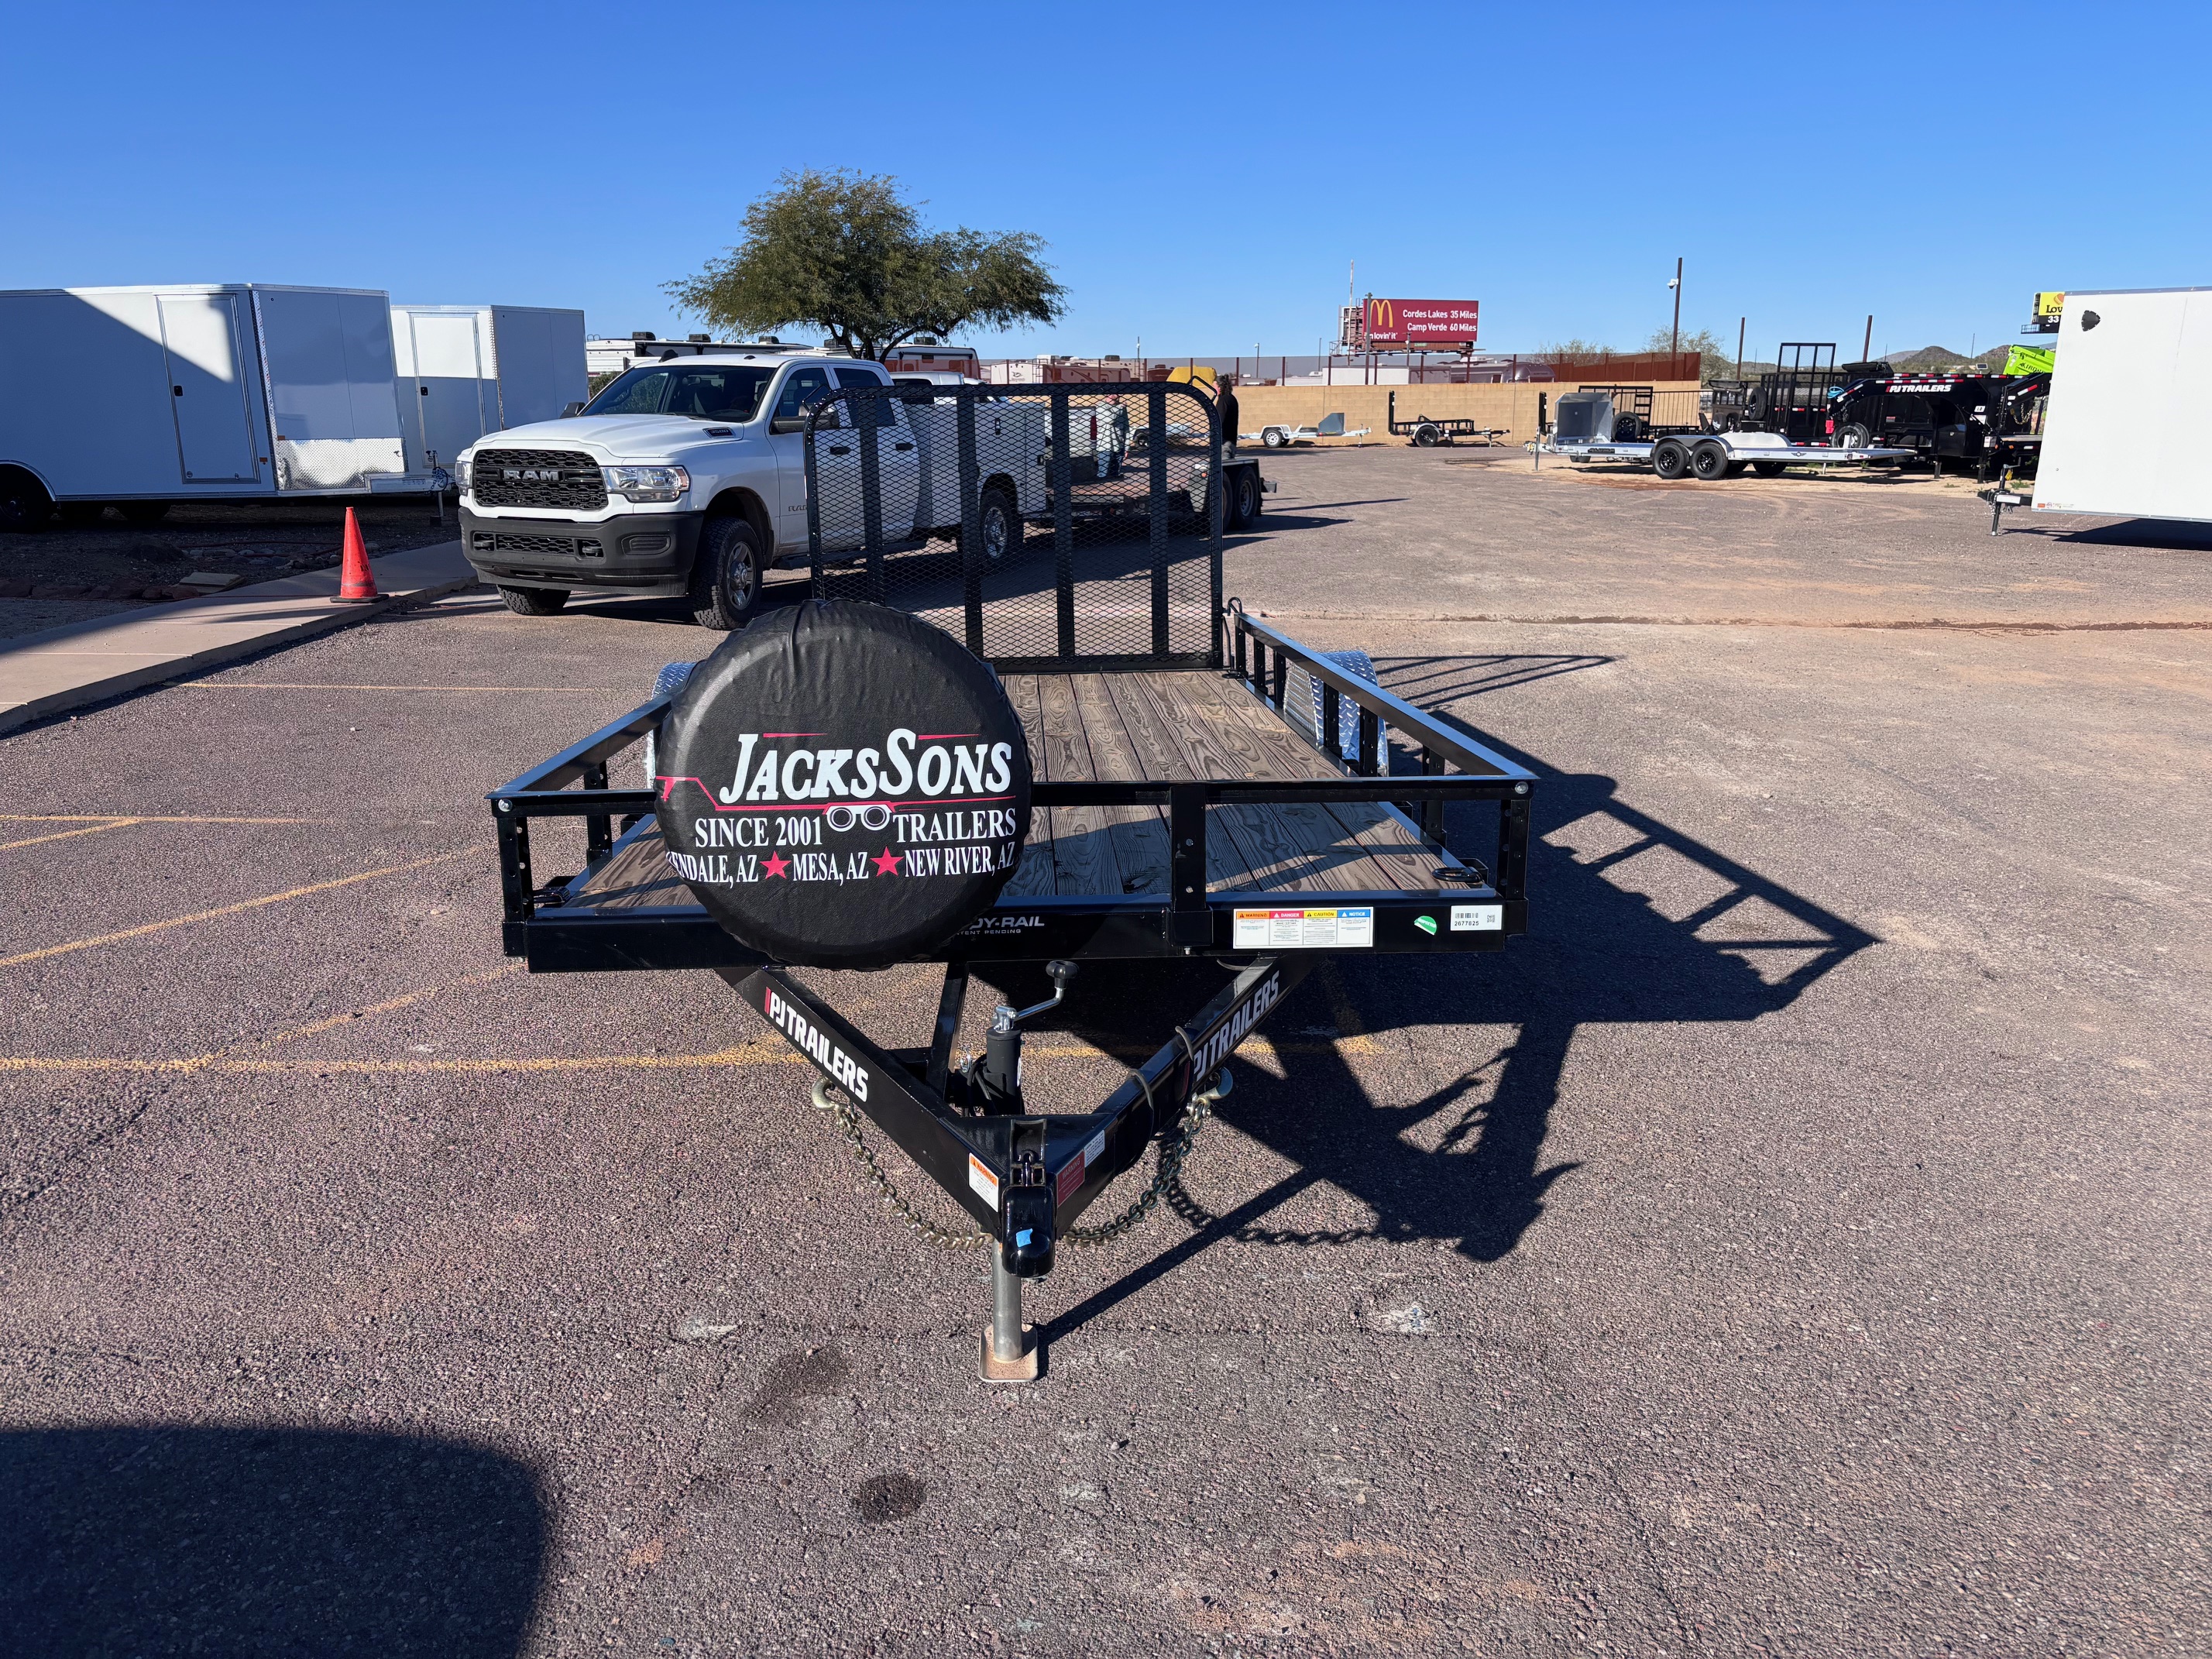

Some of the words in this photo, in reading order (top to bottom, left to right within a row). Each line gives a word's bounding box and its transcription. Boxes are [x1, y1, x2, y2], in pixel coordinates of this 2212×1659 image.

[1403, 309, 1427, 318] Cordes
[1428, 310, 1448, 318] Lakes
[1460, 311, 1477, 319] Miles
[1407, 323, 1427, 332] Camp
[1427, 323, 1448, 331] Verde
[503, 470, 559, 481] RAM
[695, 817, 769, 848] SINCE
[775, 816, 823, 847] 2001
[892, 808, 1016, 843] TRAILERS
[736, 854, 759, 882] AZ
[792, 853, 843, 886] MESA,
[847, 852, 869, 879] AZ
[905, 848, 940, 878] NEW
[944, 846, 995, 876] RIVER,
[997, 841, 1015, 869] AZ
[1063, 1158, 1080, 1180] WARNING
